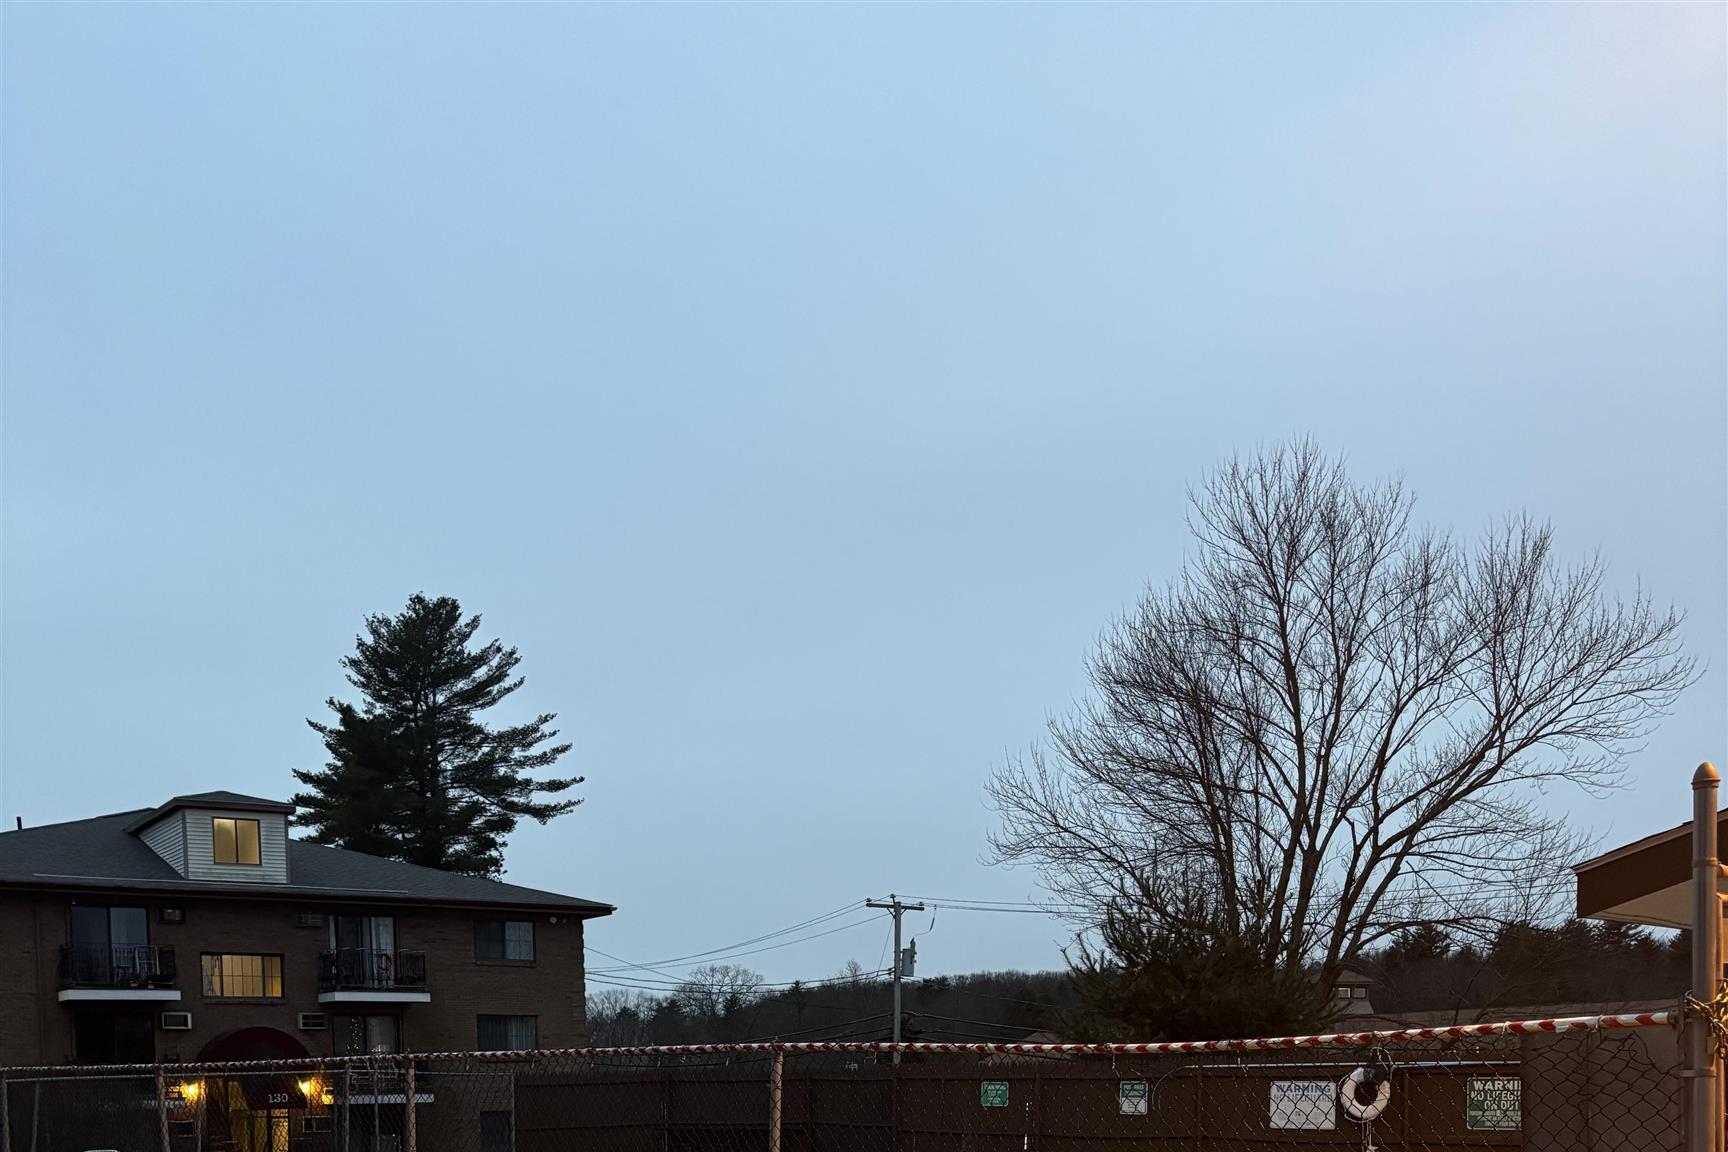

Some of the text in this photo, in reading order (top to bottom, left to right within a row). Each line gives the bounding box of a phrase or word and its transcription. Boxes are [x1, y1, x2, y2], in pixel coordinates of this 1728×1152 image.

[1276, 1084, 1331, 1094] WARNING
[1473, 1080, 1521, 1090] WARNI
[267, 1093, 289, 1103] 130
[1471, 1090, 1521, 1101] NO LIFEGU
[1484, 1100, 1520, 1111] ON DUT
